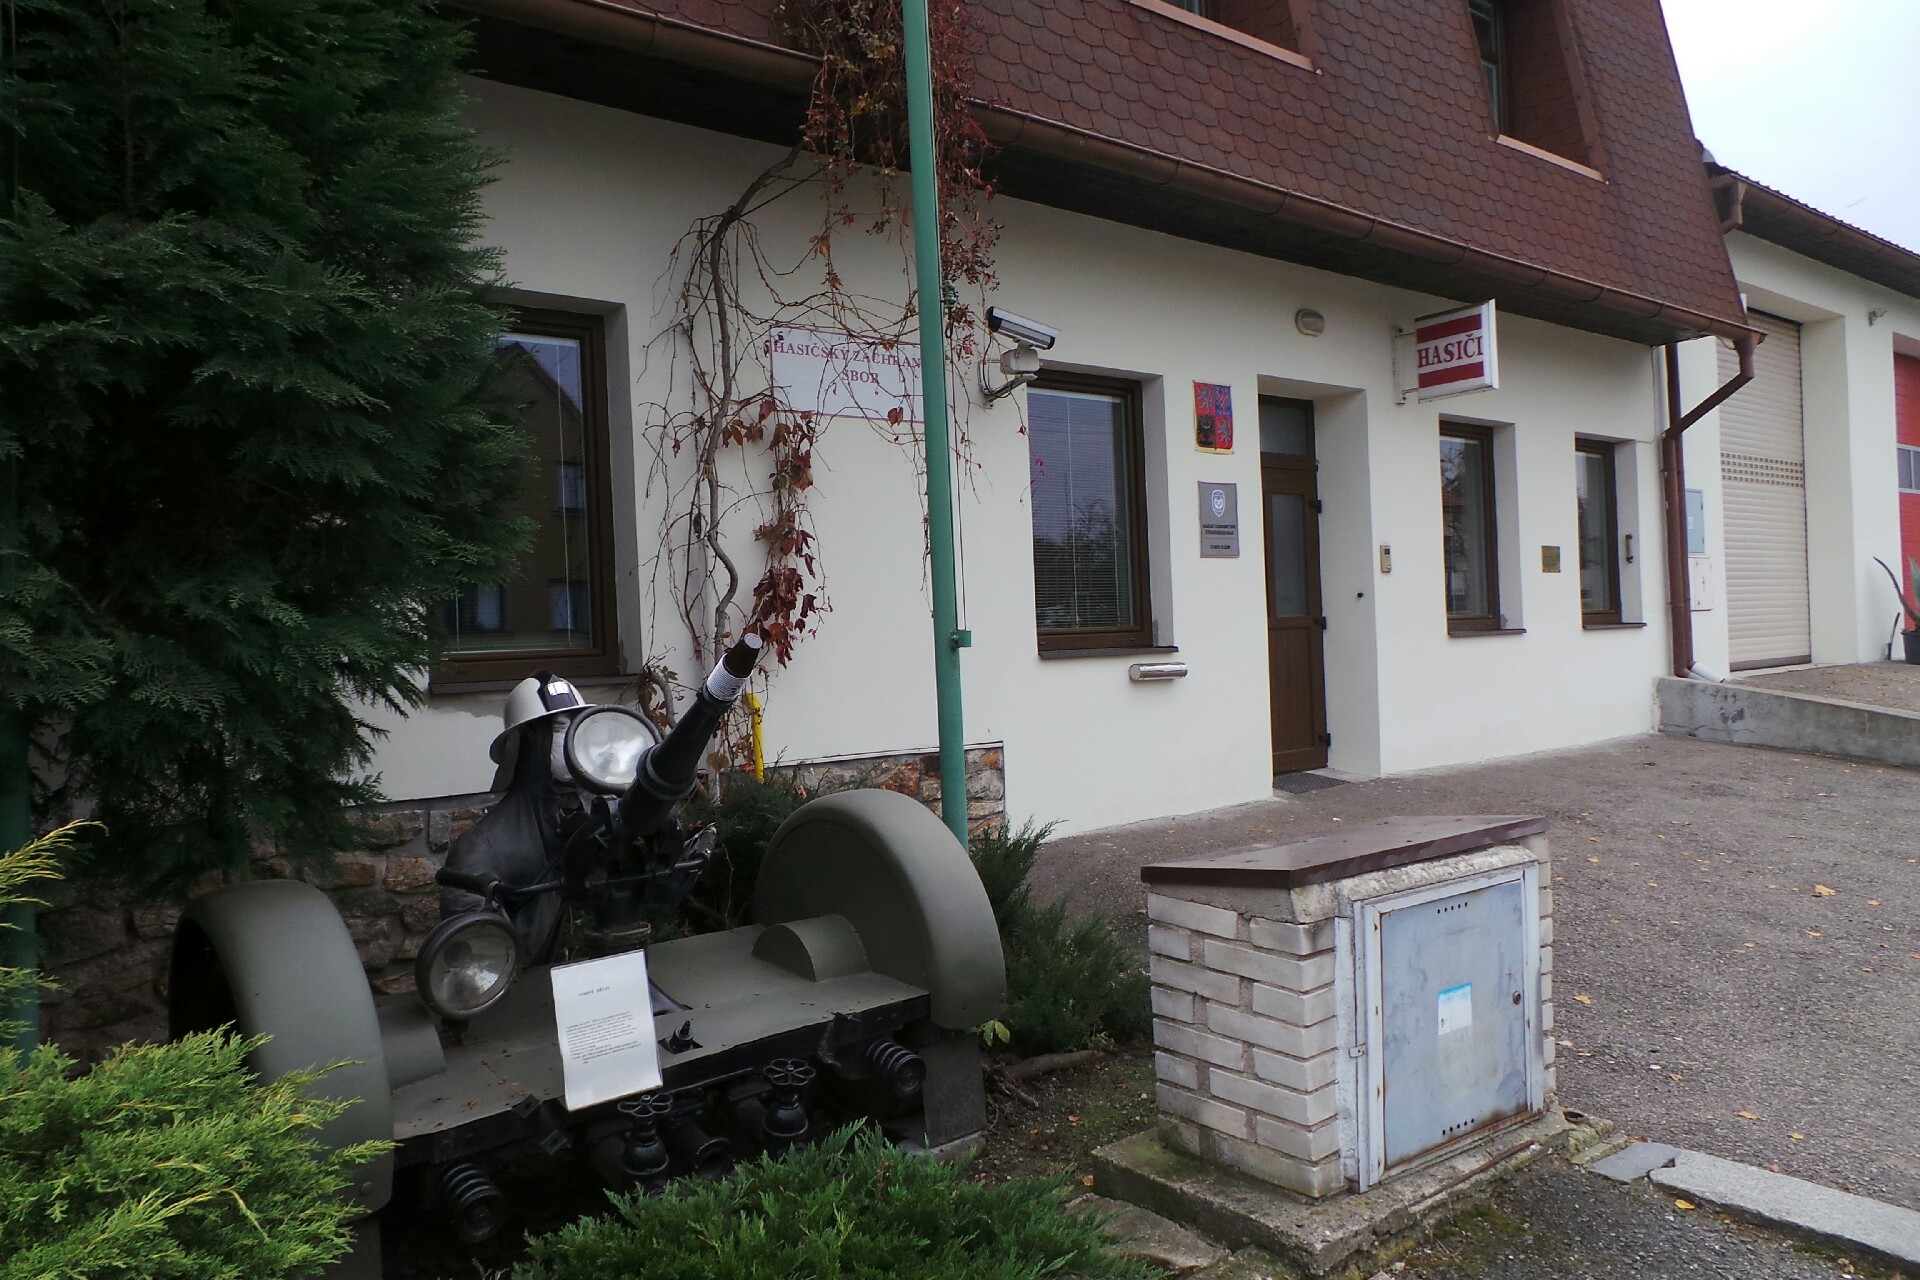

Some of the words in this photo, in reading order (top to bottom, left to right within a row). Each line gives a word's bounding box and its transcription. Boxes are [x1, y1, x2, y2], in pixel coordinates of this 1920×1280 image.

[773, 342, 849, 361] HASIČSKÝ
[1417, 333, 1483, 368] HASIČI
[841, 369, 880, 384] SBOR
